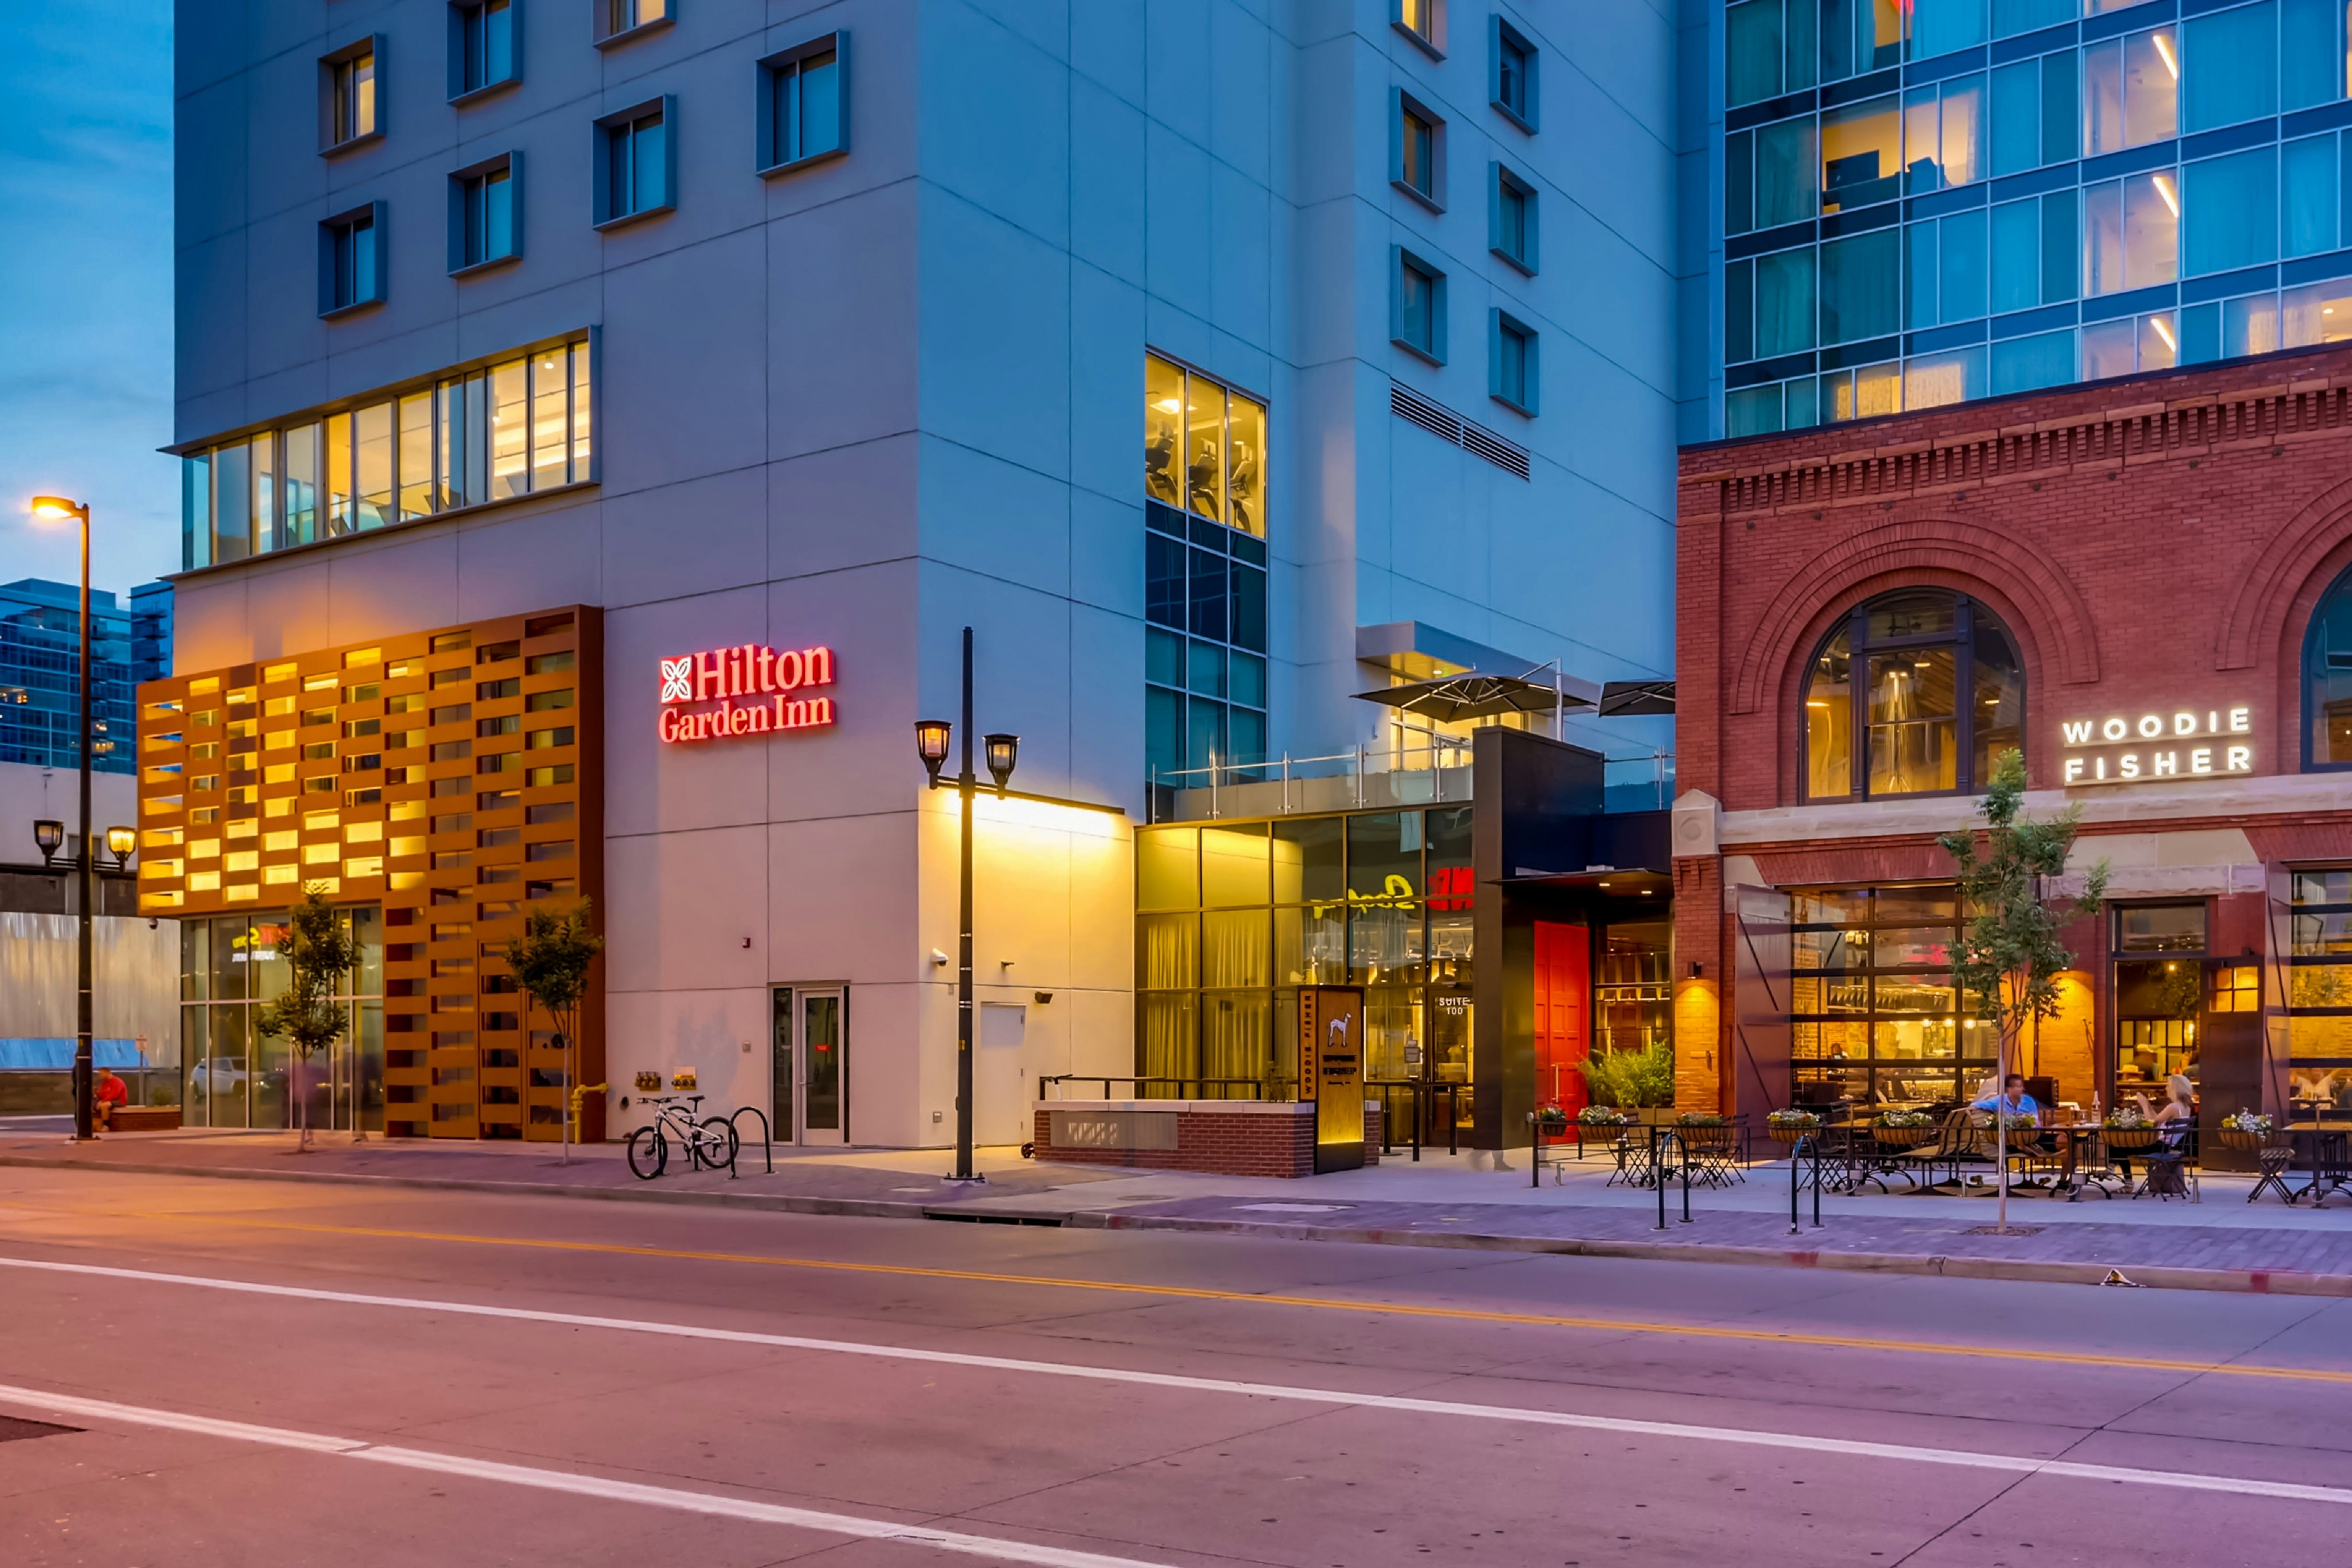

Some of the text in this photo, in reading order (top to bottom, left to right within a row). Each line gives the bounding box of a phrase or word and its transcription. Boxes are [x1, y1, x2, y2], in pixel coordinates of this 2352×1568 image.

[694, 643, 833, 701] Hilton
[658, 694, 833, 743] Garden Inn
[2062, 707, 2249, 744] WOODIE
[2065, 746, 2250, 782] FISHER
[1439, 997, 1469, 1006] SUITE
[1446, 1007, 1463, 1015] 100
